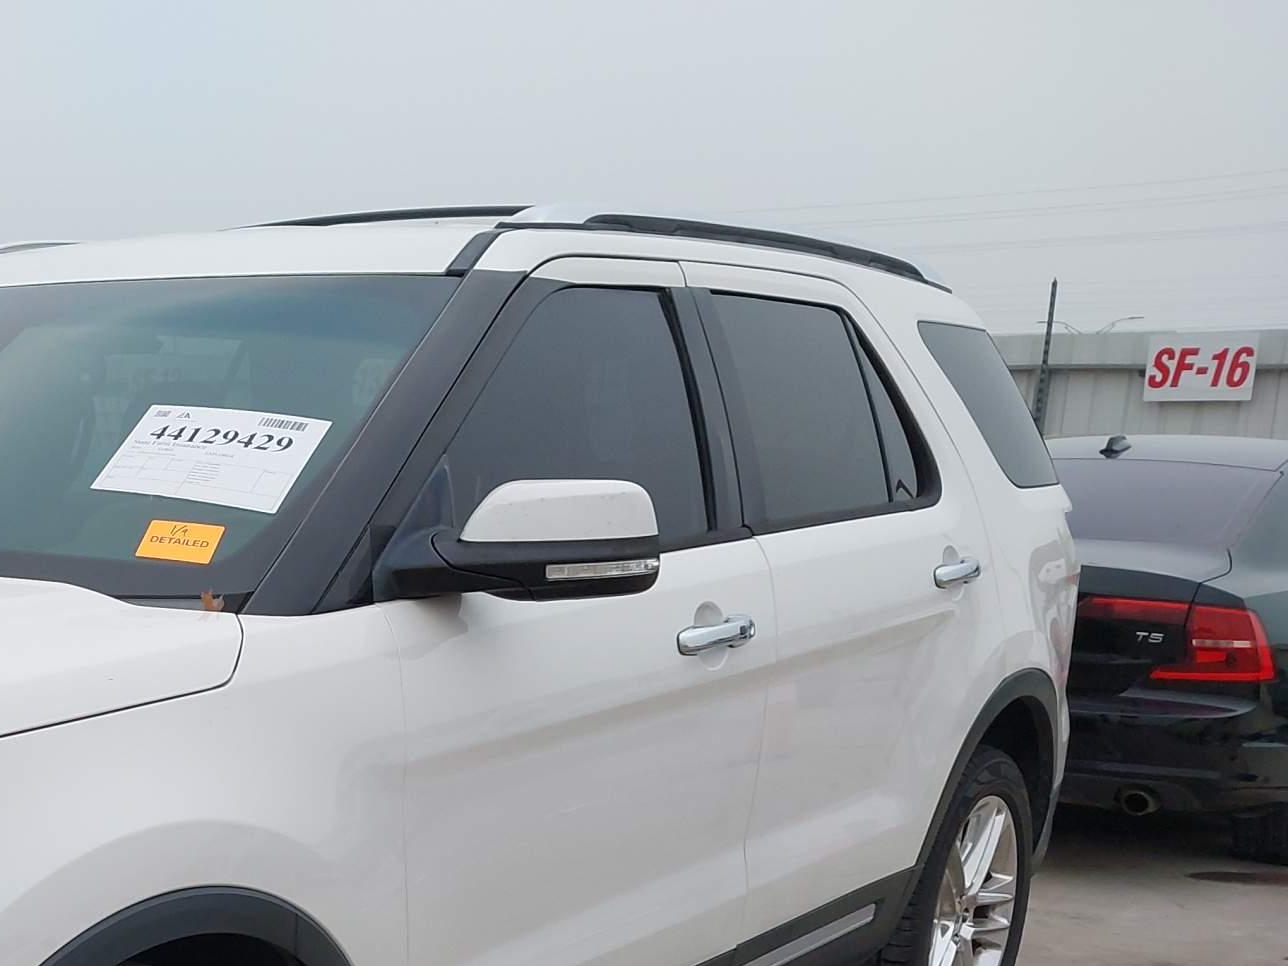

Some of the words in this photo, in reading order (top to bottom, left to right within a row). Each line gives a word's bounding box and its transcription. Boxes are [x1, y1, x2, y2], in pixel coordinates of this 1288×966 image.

[1148, 347, 1254, 388] SF-16
[150, 424, 294, 453] 44129429
[150, 535, 210, 548] DETAILED
